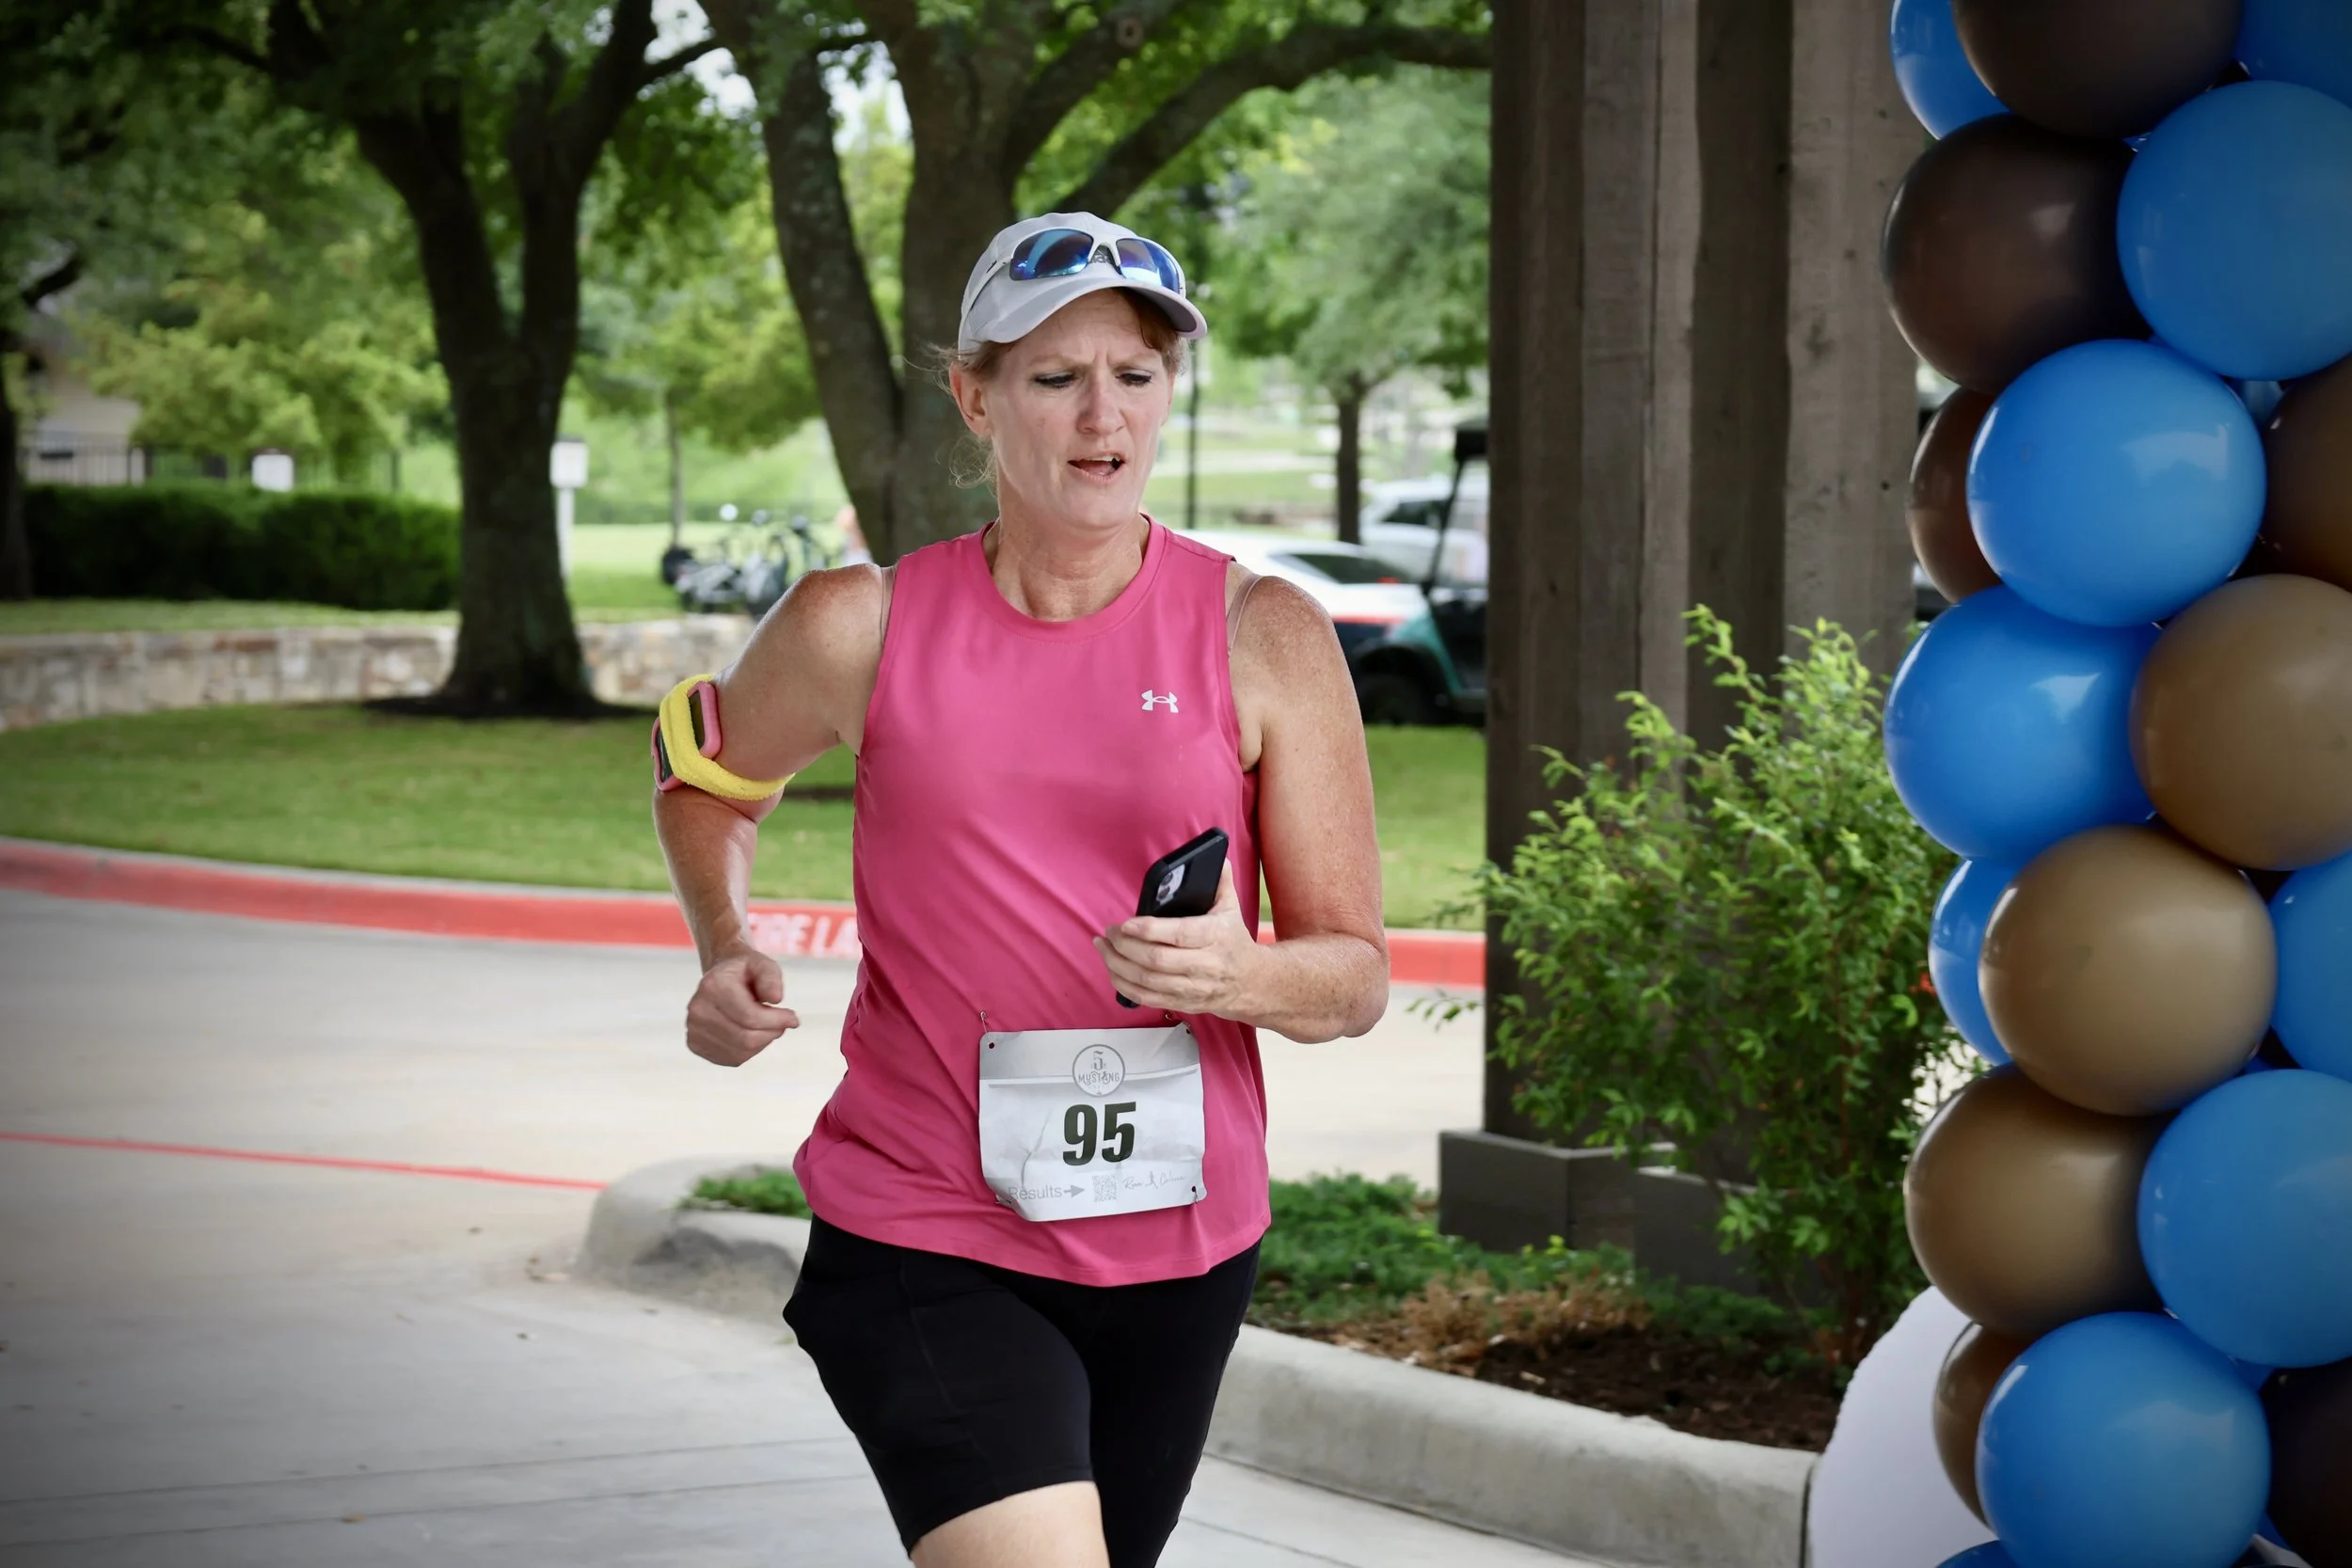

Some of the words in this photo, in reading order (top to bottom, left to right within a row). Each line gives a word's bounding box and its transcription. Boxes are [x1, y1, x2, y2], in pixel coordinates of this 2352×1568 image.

[1078, 1070, 1120, 1085] MUSTANG
[1062, 1101, 1136, 1166] 95
[1008, 1184, 1063, 1200] Results
